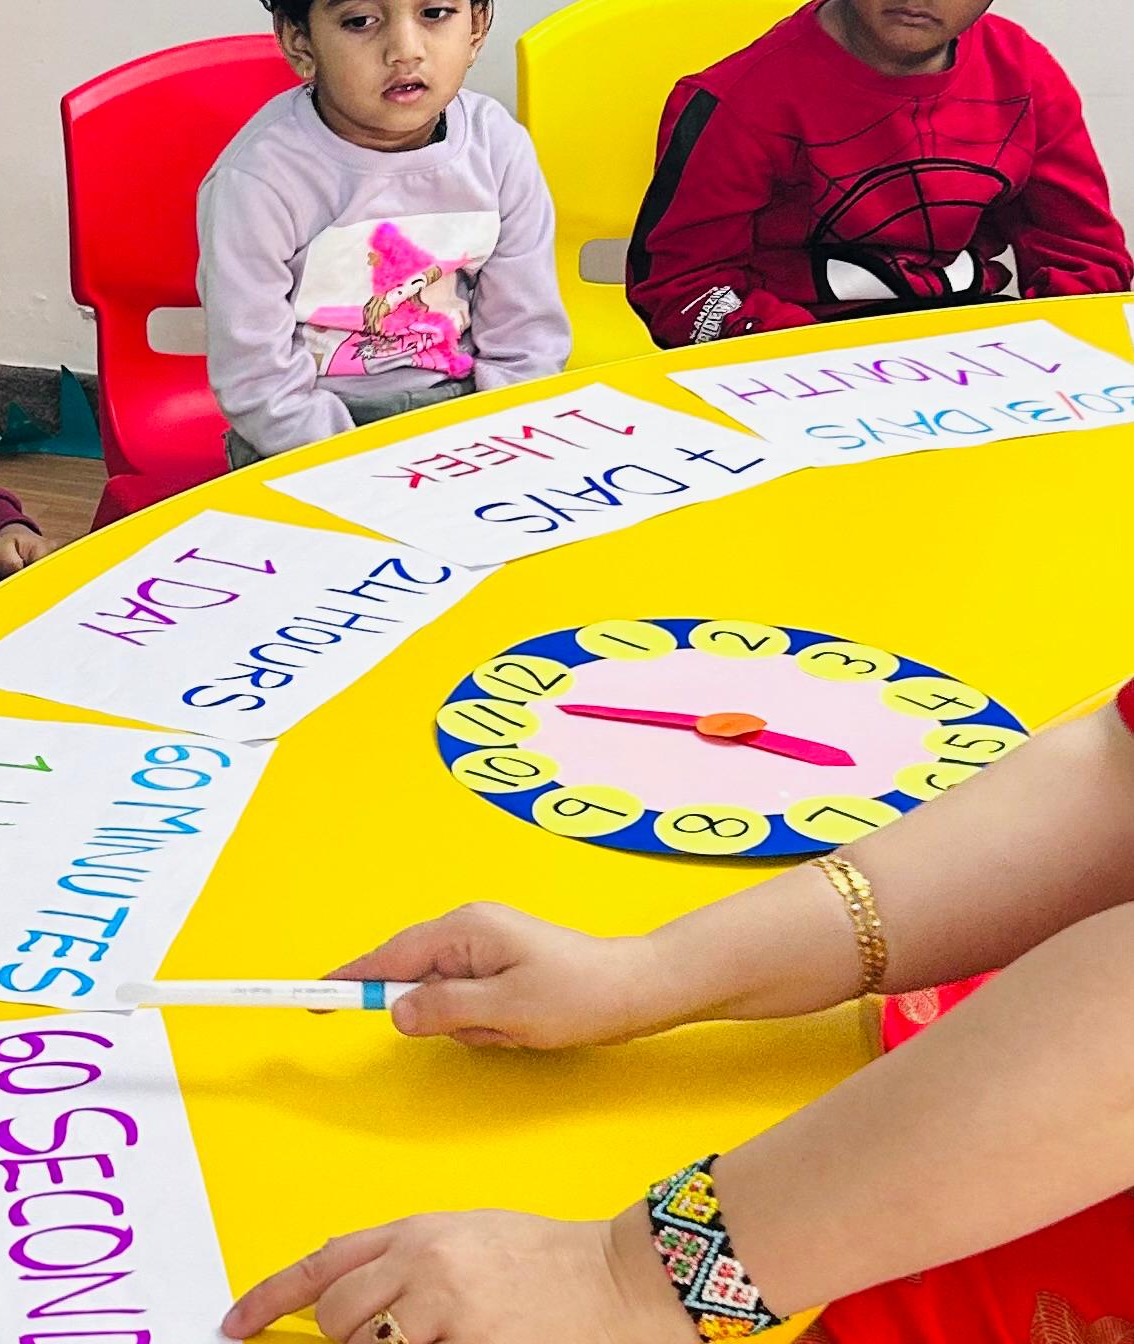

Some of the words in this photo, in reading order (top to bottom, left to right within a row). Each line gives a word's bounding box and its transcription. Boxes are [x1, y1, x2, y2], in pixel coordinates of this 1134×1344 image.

[978, 341, 1061, 374] 1
[717, 351, 1006, 406] MONTH
[555, 409, 635, 436] 1
[804, 408, 994, 450] DAYS
[372, 425, 589, 489] WEEK
[675, 447, 765, 475] 7
[474, 463, 691, 534] DAYS
[174, 547, 277, 575] 1
[325, 557, 452, 603] 24
[78, 577, 240, 647] DAY
[599, 632, 651, 652] 1
[710, 630, 771, 652] 2
[181, 605, 404, 712] HOURS
[810, 650, 877, 675] 3
[482, 661, 568, 697] 12
[894, 692, 976, 712] 4
[453, 702, 527, 738] 11
[942, 733, 1006, 755] 5
[130, 742, 233, 793] 60
[463, 756, 542, 788] 10
[552, 796, 629, 818] 9
[803, 805, 880, 829] 7
[672, 813, 750, 839] 8
